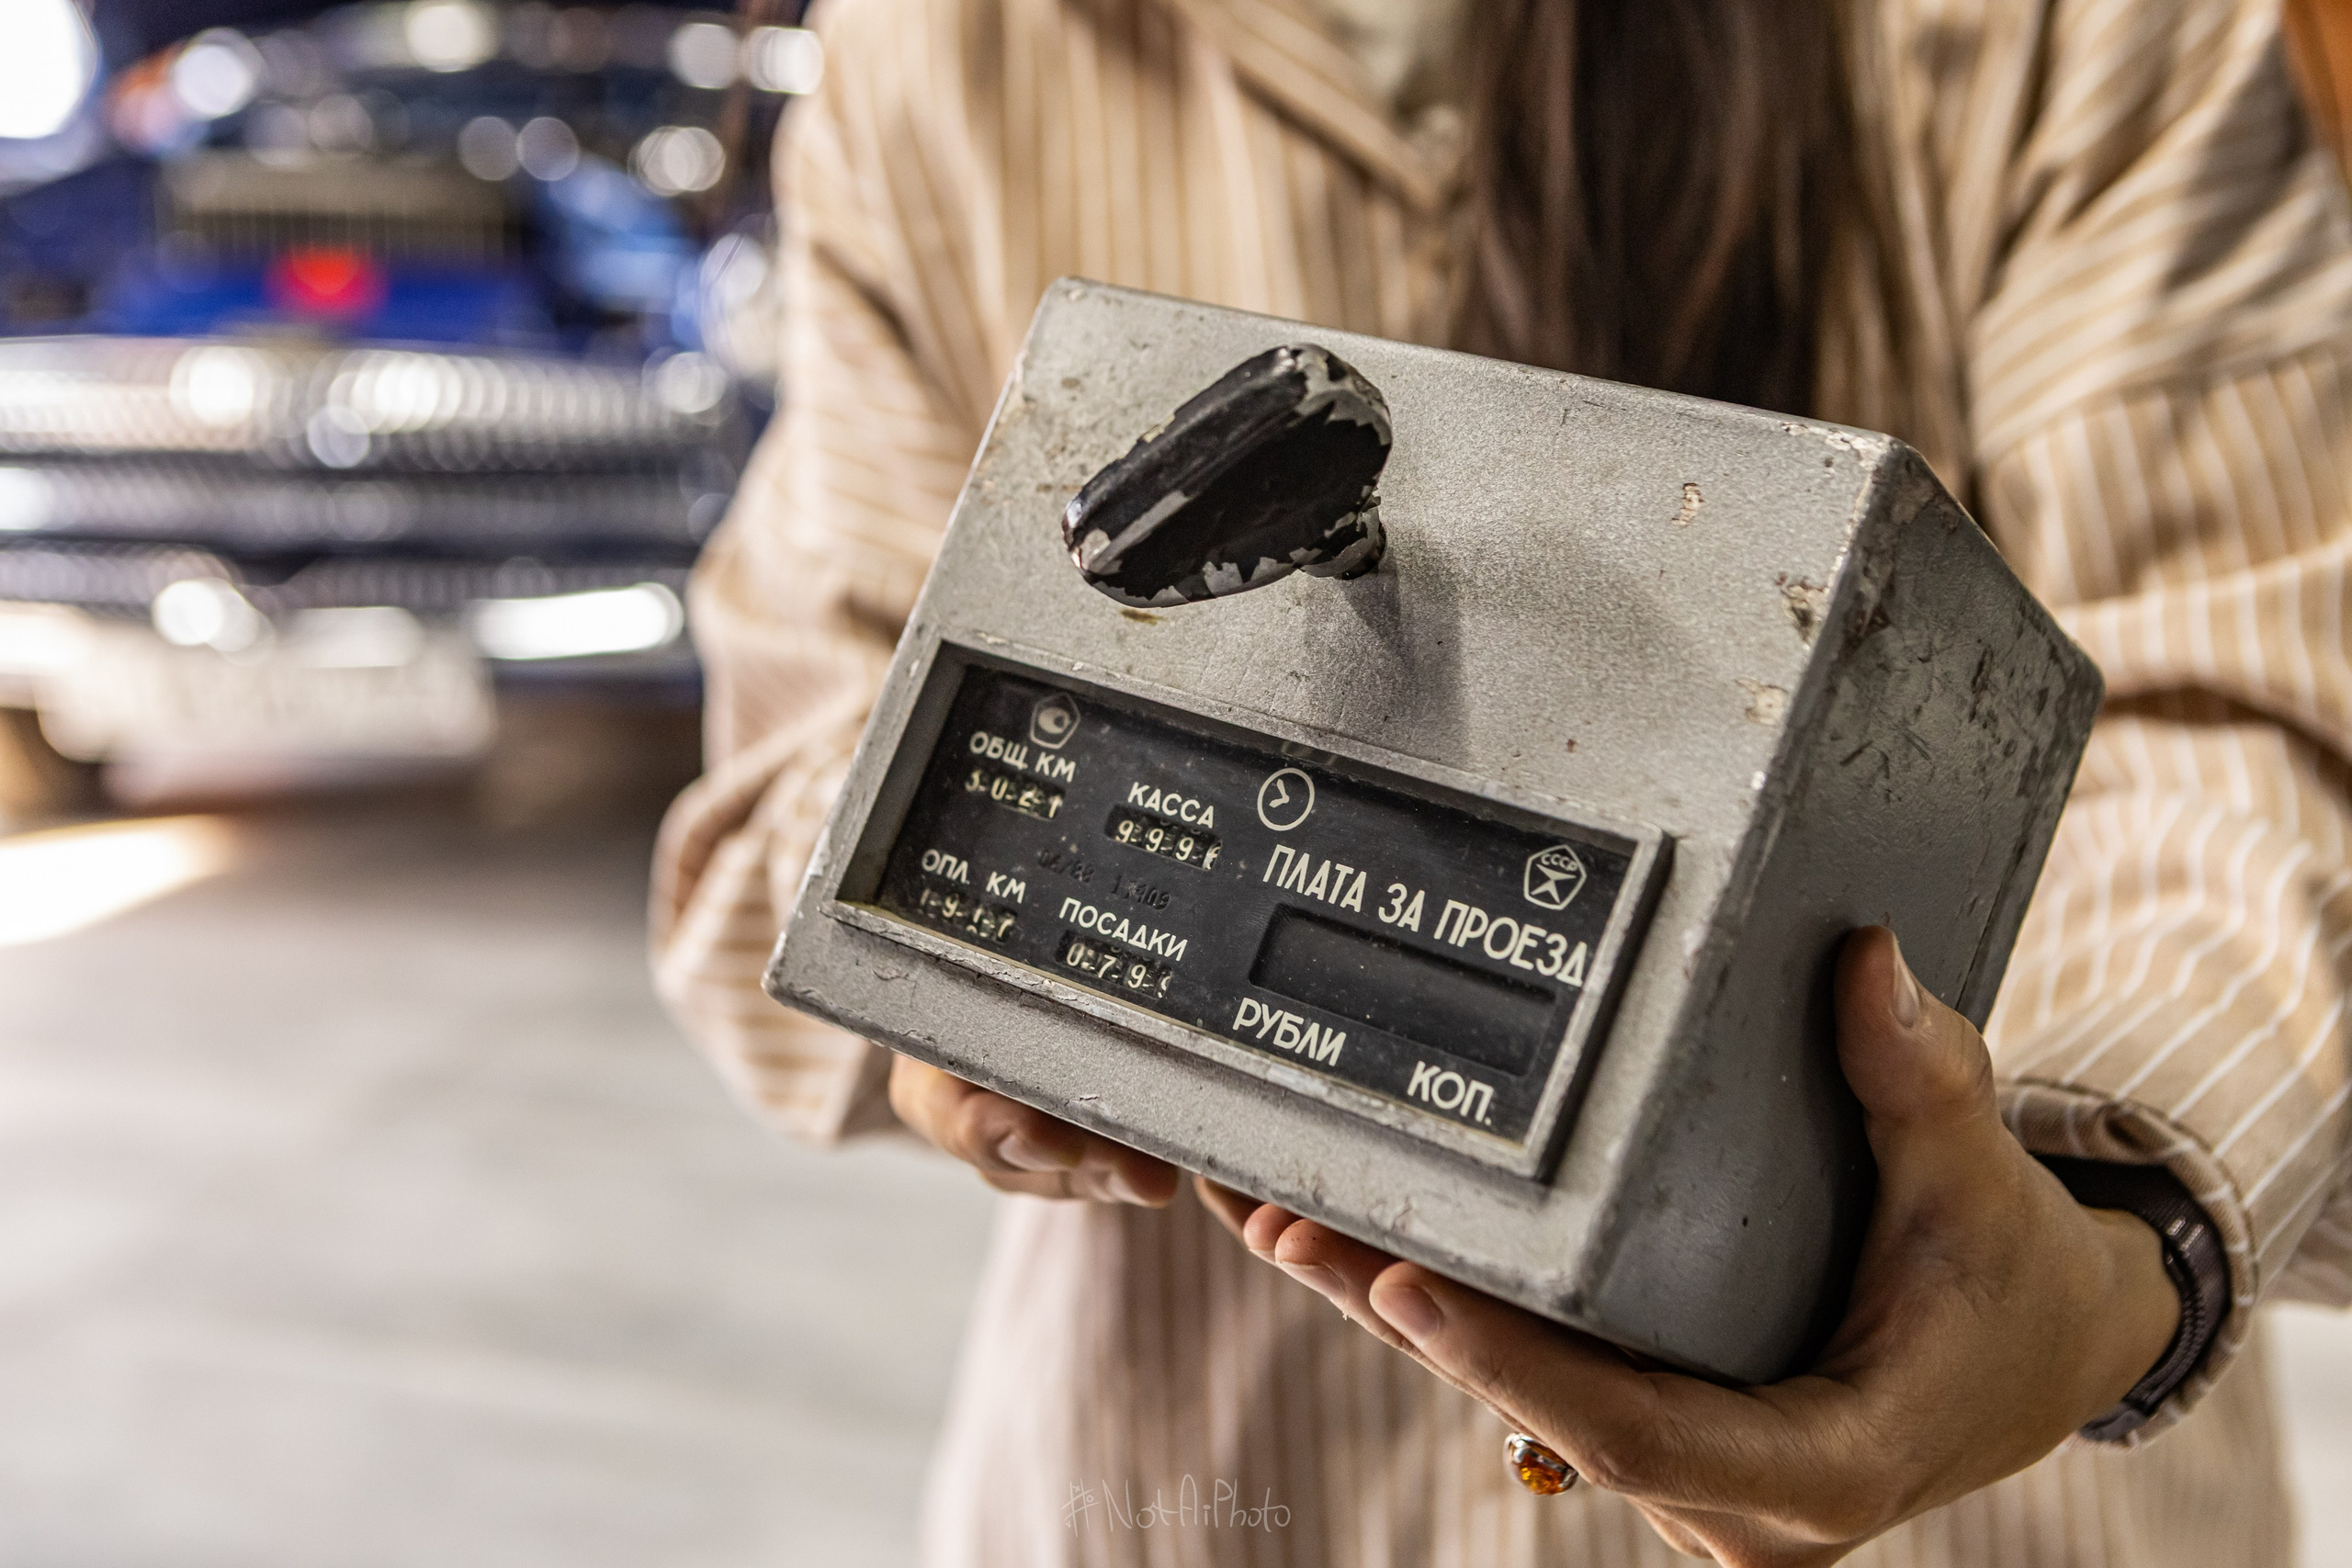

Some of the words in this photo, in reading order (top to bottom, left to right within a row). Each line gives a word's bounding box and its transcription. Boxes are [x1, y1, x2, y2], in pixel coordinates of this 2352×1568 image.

[1035, 751, 1077, 784] КМ
[1127, 781, 1215, 829] КАССА
[986, 871, 1027, 905] КМ
[1541, 852, 1579, 873] СССР
[1058, 897, 1189, 963] ПОСАДКИ
[1262, 843, 1367, 913] ПЛАТА
[1378, 883, 1426, 932] ЗА
[1433, 898, 1588, 987] ПРОЕЗД
[1232, 997, 1348, 1067] РУБЛИ
[1407, 1060, 1495, 1126] КОП.
